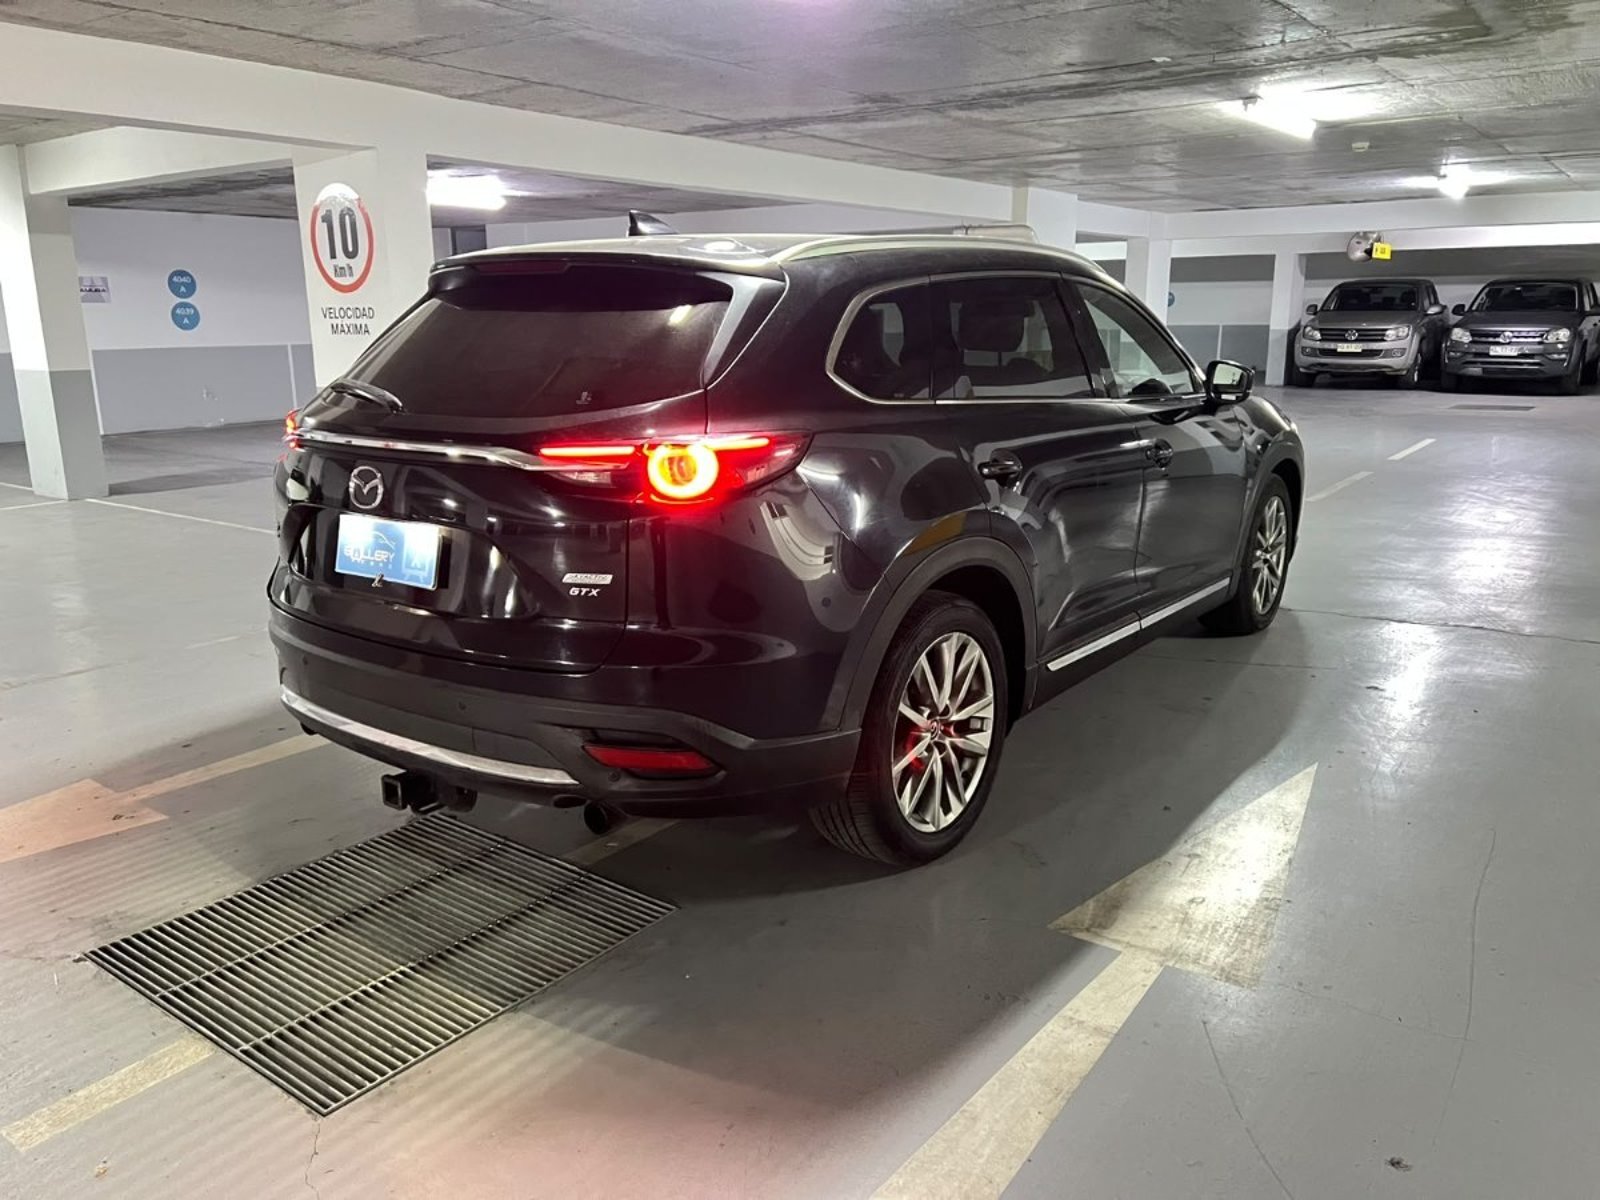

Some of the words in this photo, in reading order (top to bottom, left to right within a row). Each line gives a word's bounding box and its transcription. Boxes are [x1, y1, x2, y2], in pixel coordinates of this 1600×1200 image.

[320, 206, 359, 260] 10
[172, 276, 191, 284] 4040
[175, 307, 194, 316] 4039
[321, 306, 375, 320] VELOCIDAD
[331, 320, 370, 335] MÁXIMA
[569, 587, 601, 597] GTX
